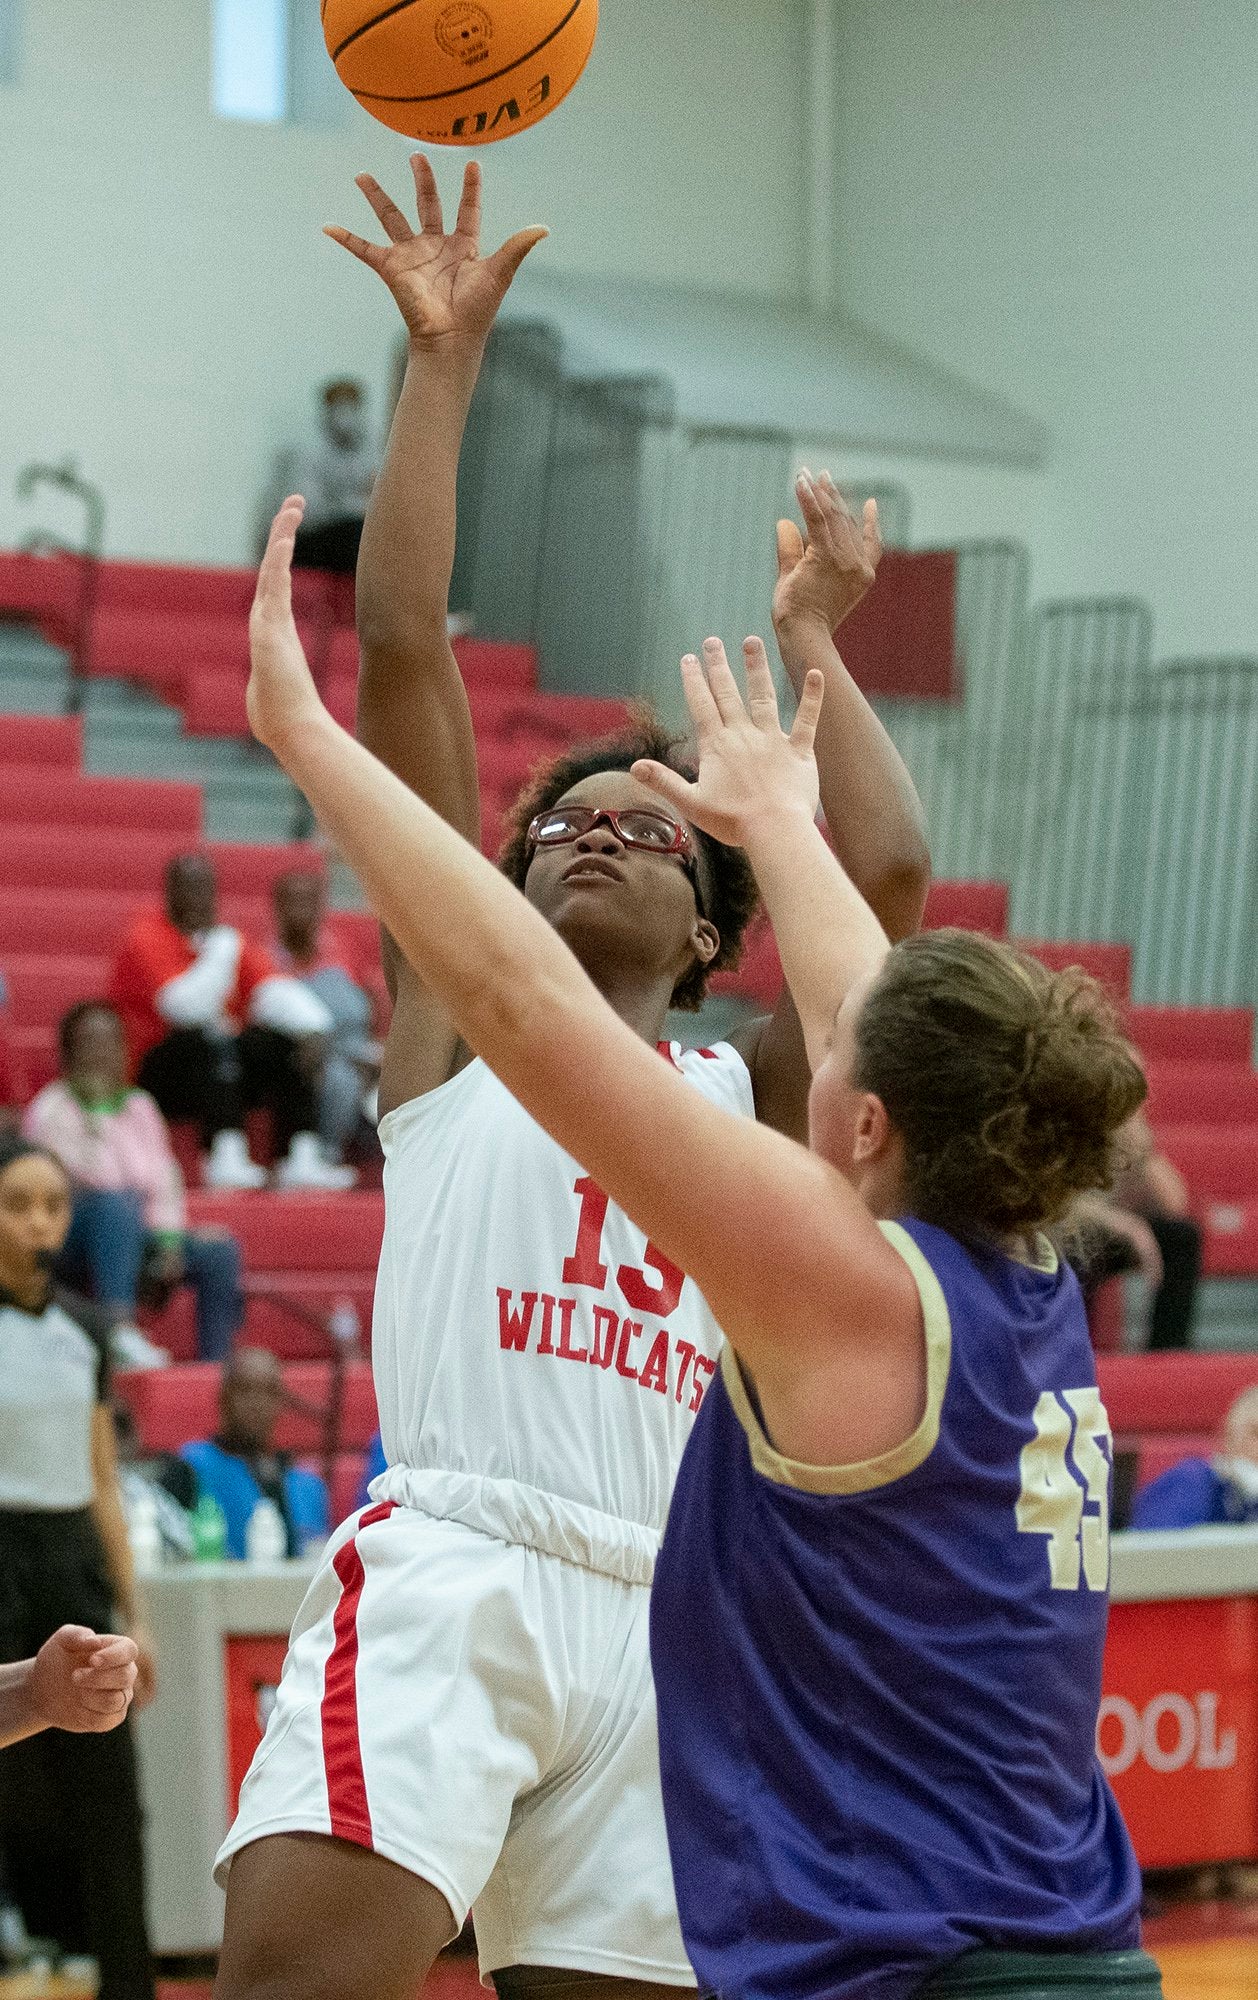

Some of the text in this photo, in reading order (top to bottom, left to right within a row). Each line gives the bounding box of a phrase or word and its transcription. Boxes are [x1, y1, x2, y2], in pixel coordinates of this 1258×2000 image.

[452, 75, 550, 136] EVO
[497, 1287, 717, 1413] WILDCATS
[1015, 1387, 1113, 1592] 45
